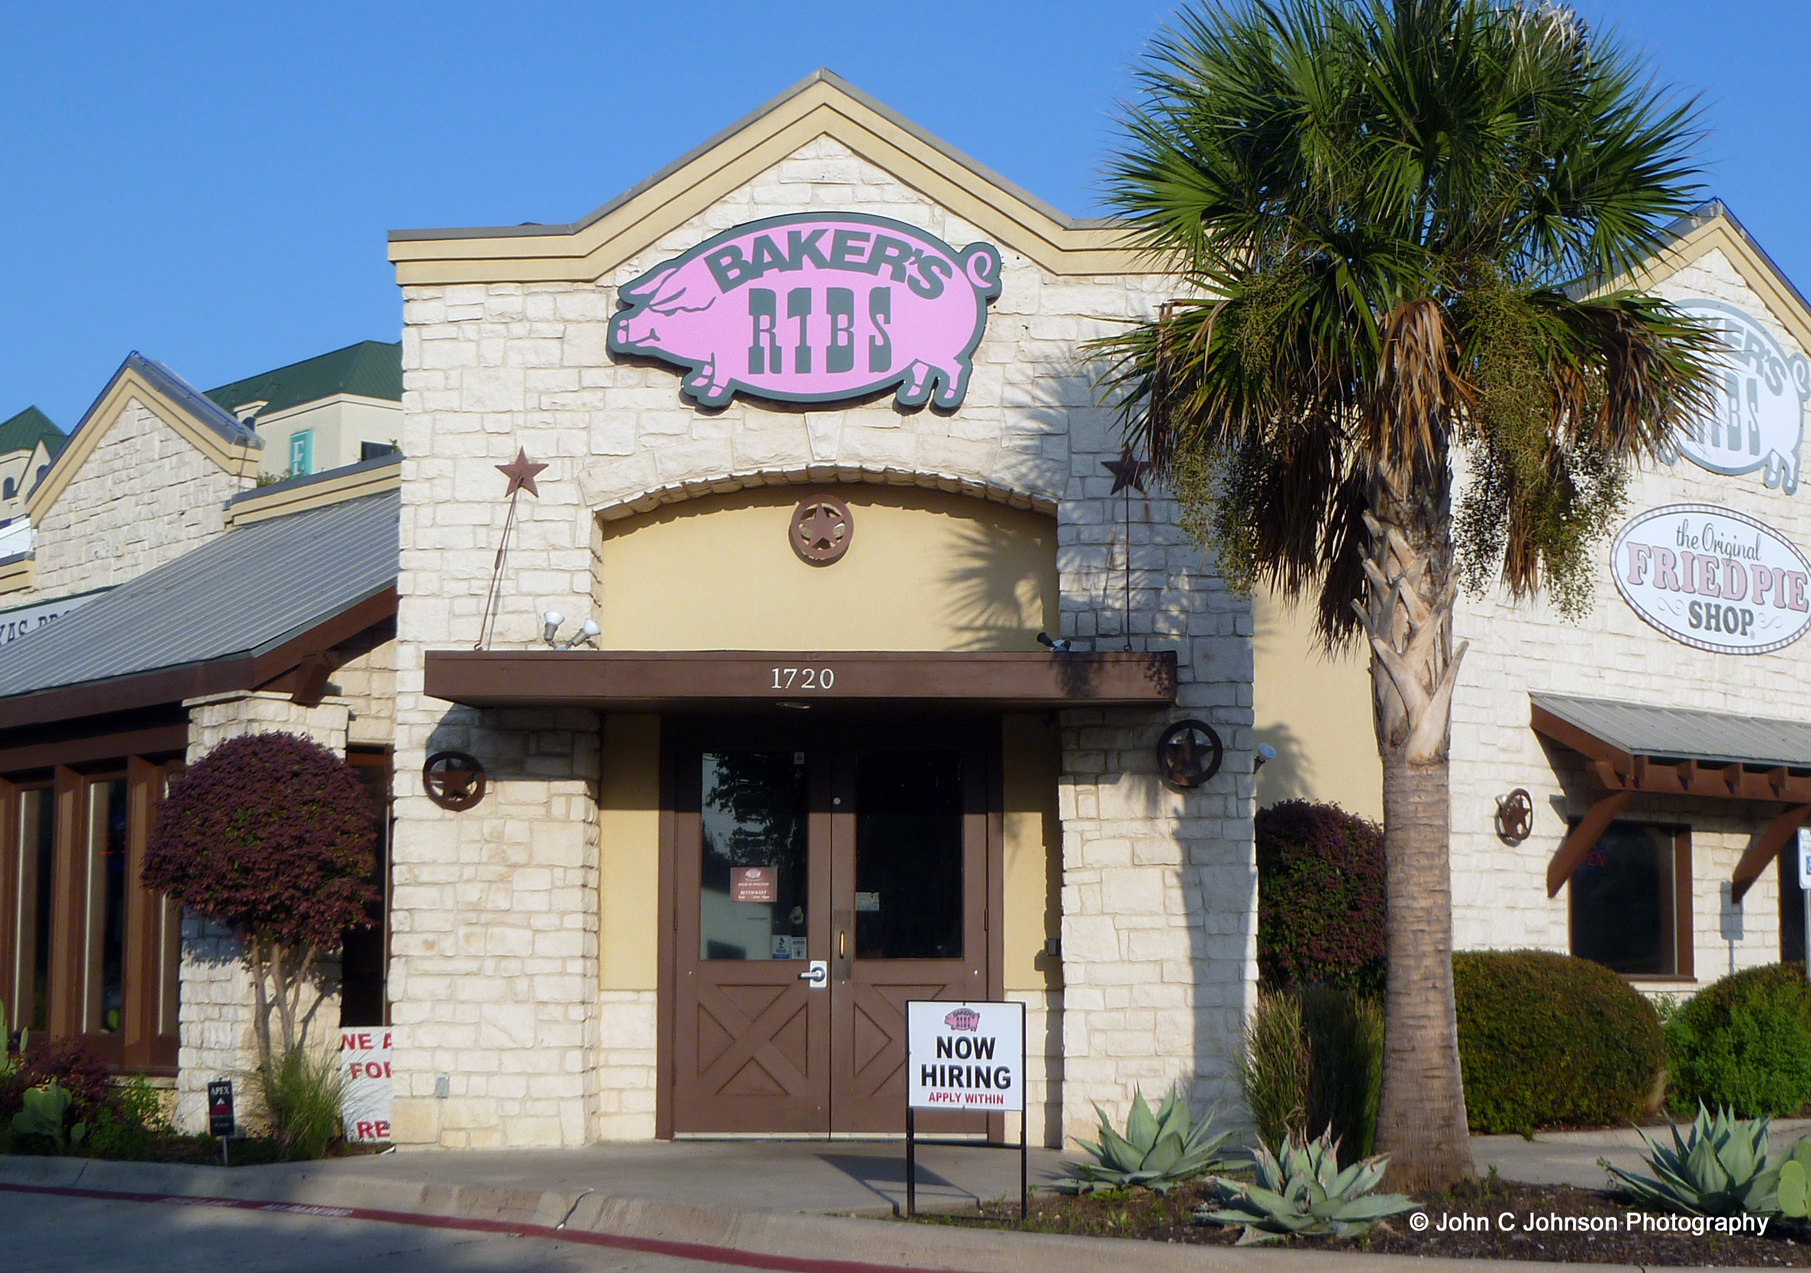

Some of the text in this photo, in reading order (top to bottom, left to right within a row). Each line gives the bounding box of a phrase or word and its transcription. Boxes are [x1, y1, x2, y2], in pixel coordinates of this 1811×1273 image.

[703, 228, 954, 300] BAKER'S
[748, 286, 892, 374] RIBS
[1676, 519, 1762, 566] the Original
[1626, 541, 1810, 613] FRIED PIE
[1688, 600, 1755, 637] SHOP
[771, 667, 835, 689] 1720
[936, 1035, 996, 1060] NOW
[921, 1063, 1011, 1090] HIRING
[929, 1092, 1004, 1105] APPLY WITHIN
